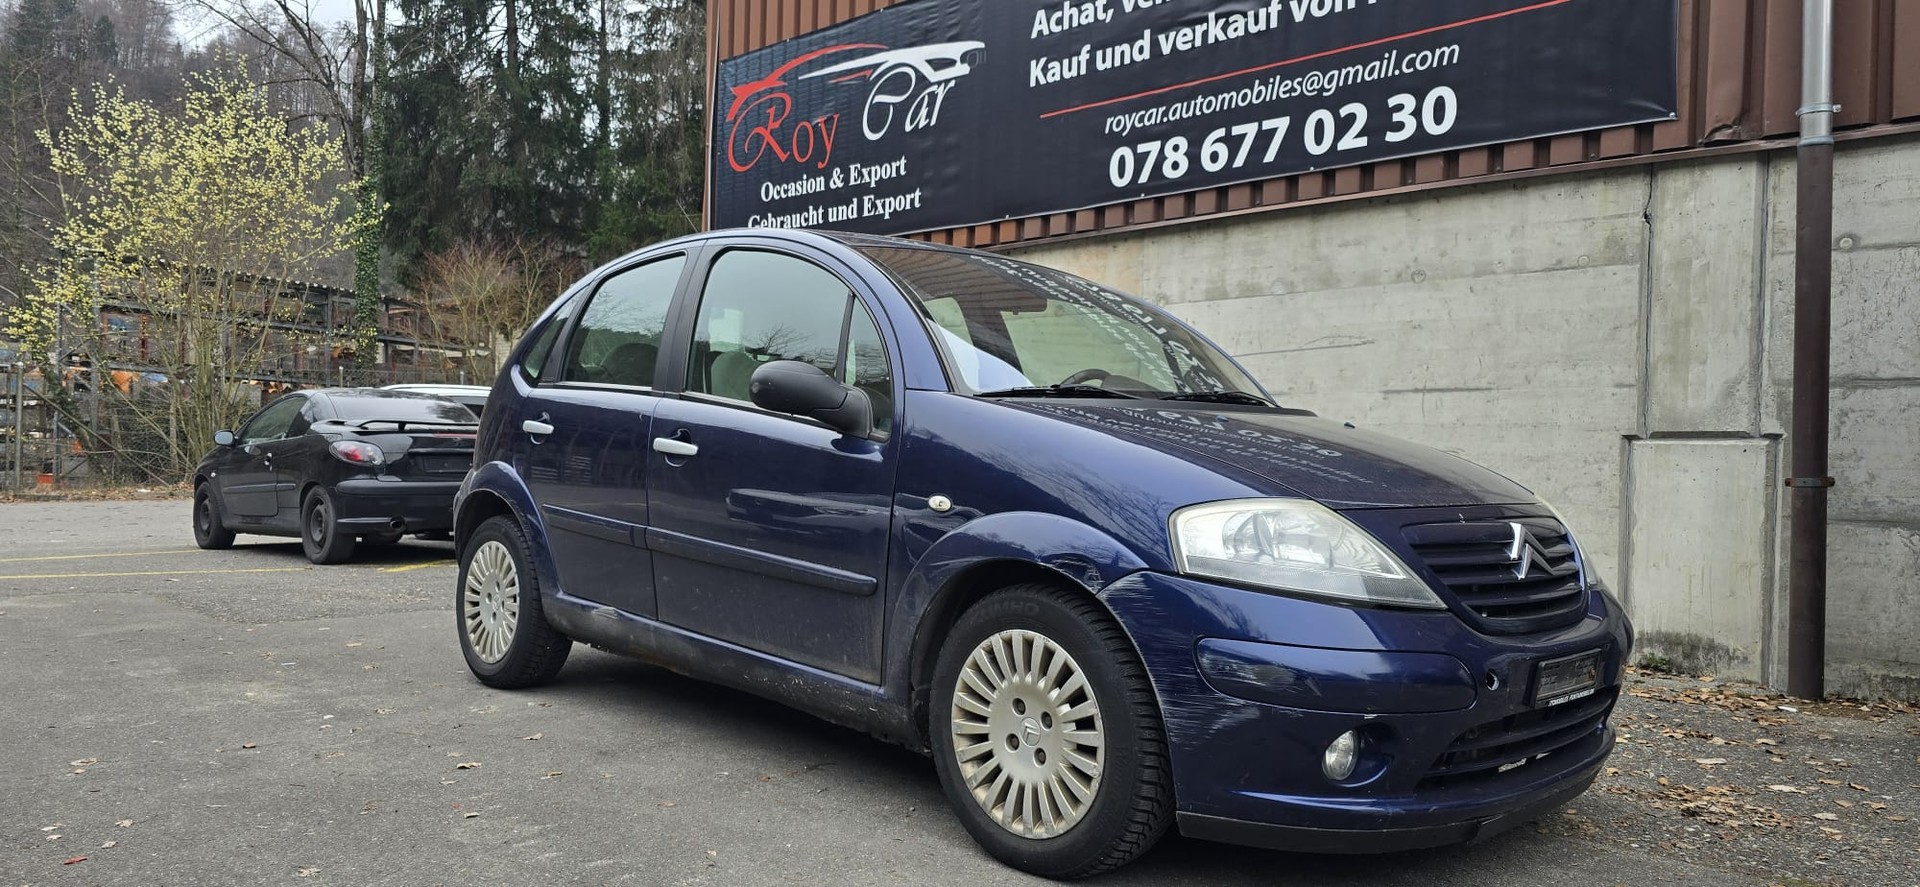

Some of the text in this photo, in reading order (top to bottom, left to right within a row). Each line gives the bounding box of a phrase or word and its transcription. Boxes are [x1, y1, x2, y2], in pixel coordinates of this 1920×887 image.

[1030, 44, 1091, 87] Kauf
[1096, 29, 1151, 71] und
[1158, 5, 1283, 55] verkauf
[1031, 0, 1114, 39] Achat,
[727, 66, 956, 172] Roy Car
[1105, 44, 1460, 136] roycar.automobiles@gmail.com
[1109, 86, 1458, 187] 078 677 02 30
[748, 187, 922, 229] Gebraucht und Export
[760, 155, 907, 202] Occasion & Export
